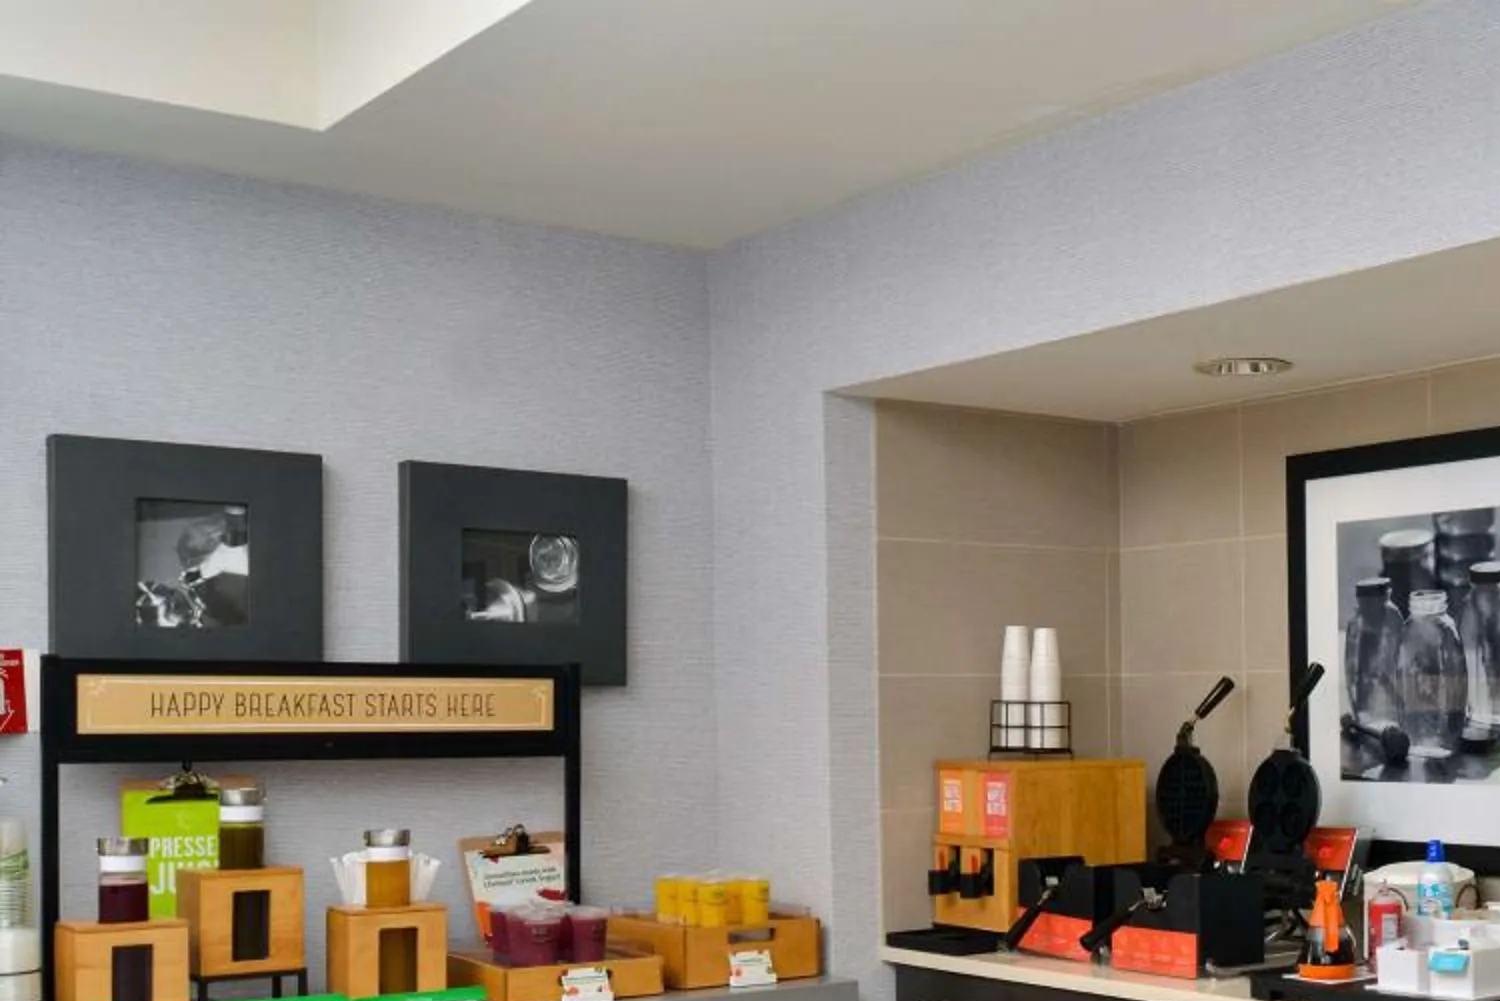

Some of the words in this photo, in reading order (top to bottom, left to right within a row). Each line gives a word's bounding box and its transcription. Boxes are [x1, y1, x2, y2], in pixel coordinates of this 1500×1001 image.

[151, 690, 225, 718] HAPPY
[235, 691, 355, 718] BREAKFAST
[365, 692, 438, 718] STARTS
[447, 692, 497, 718] HERE
[149, 836, 217, 859] PRESSE
